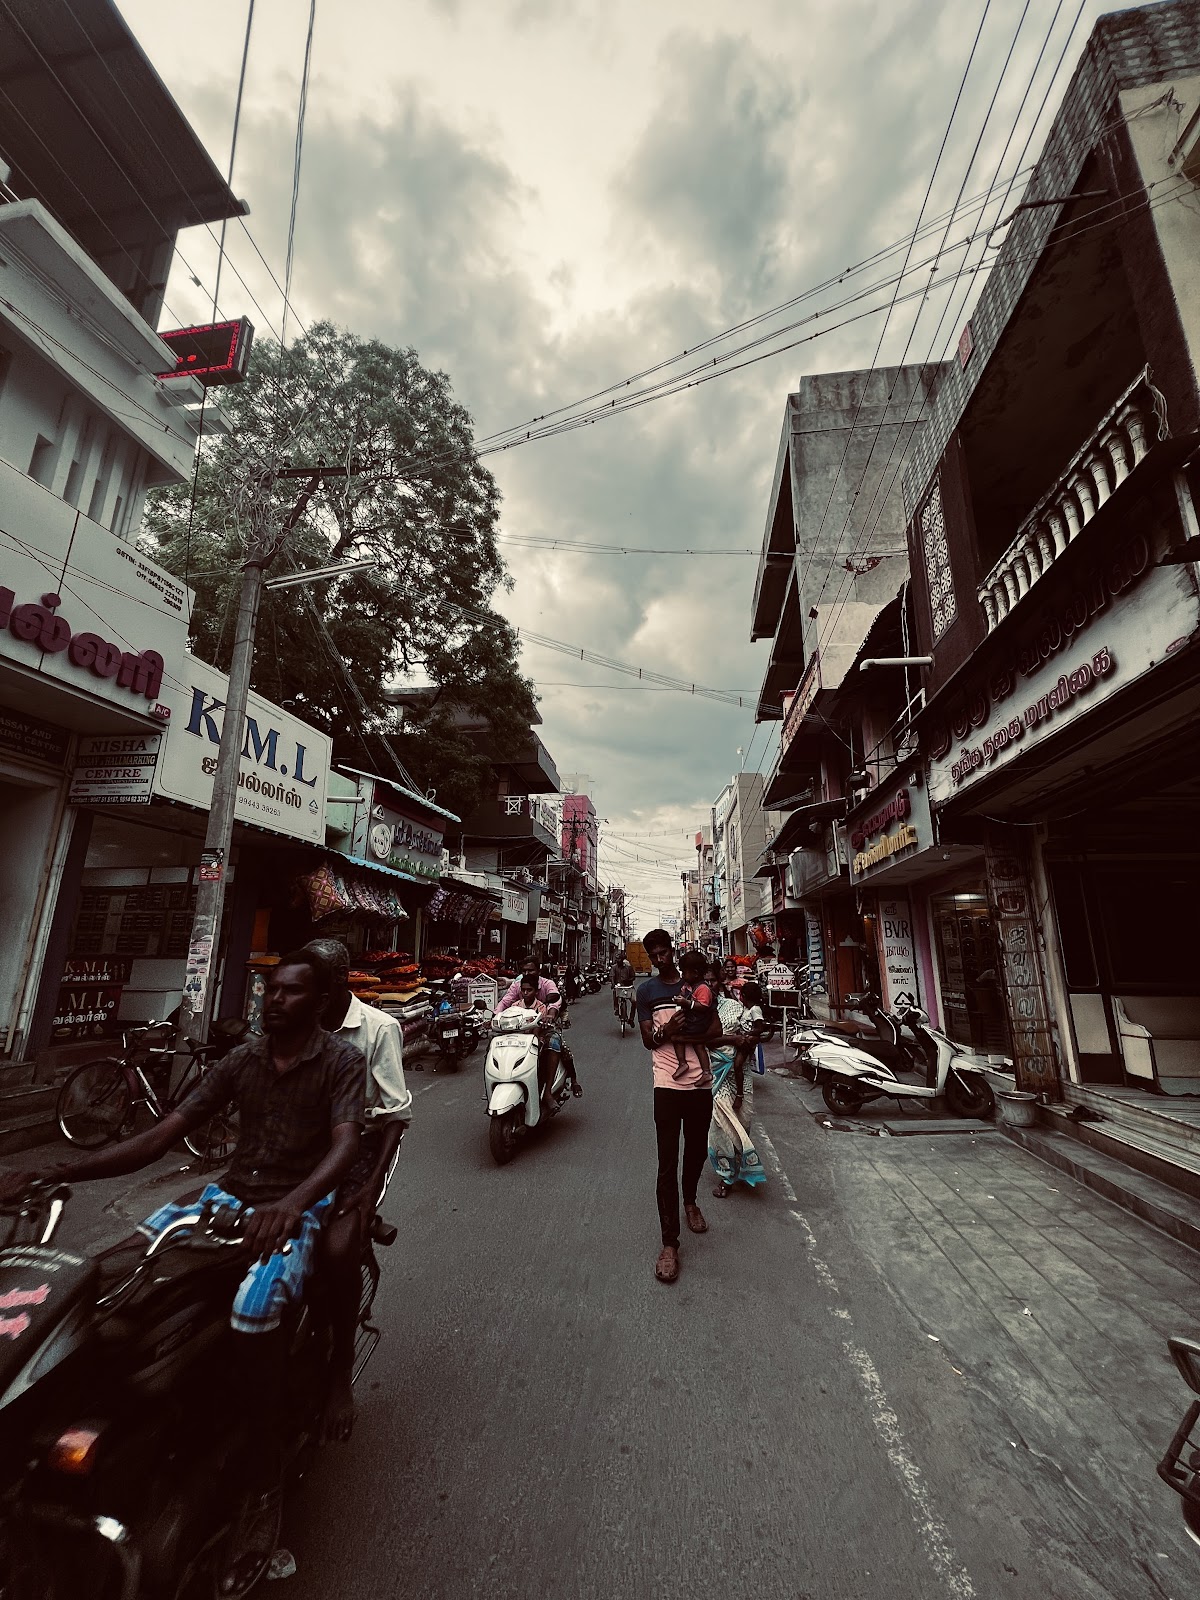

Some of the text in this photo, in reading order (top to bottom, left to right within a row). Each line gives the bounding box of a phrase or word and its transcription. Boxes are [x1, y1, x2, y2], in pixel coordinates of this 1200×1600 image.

[90, 739, 148, 753] NISHA
[184, 686, 318, 788] KM.L
[982, 716, 1021, 767] நகை
[85, 768, 143, 778] CENTRE
